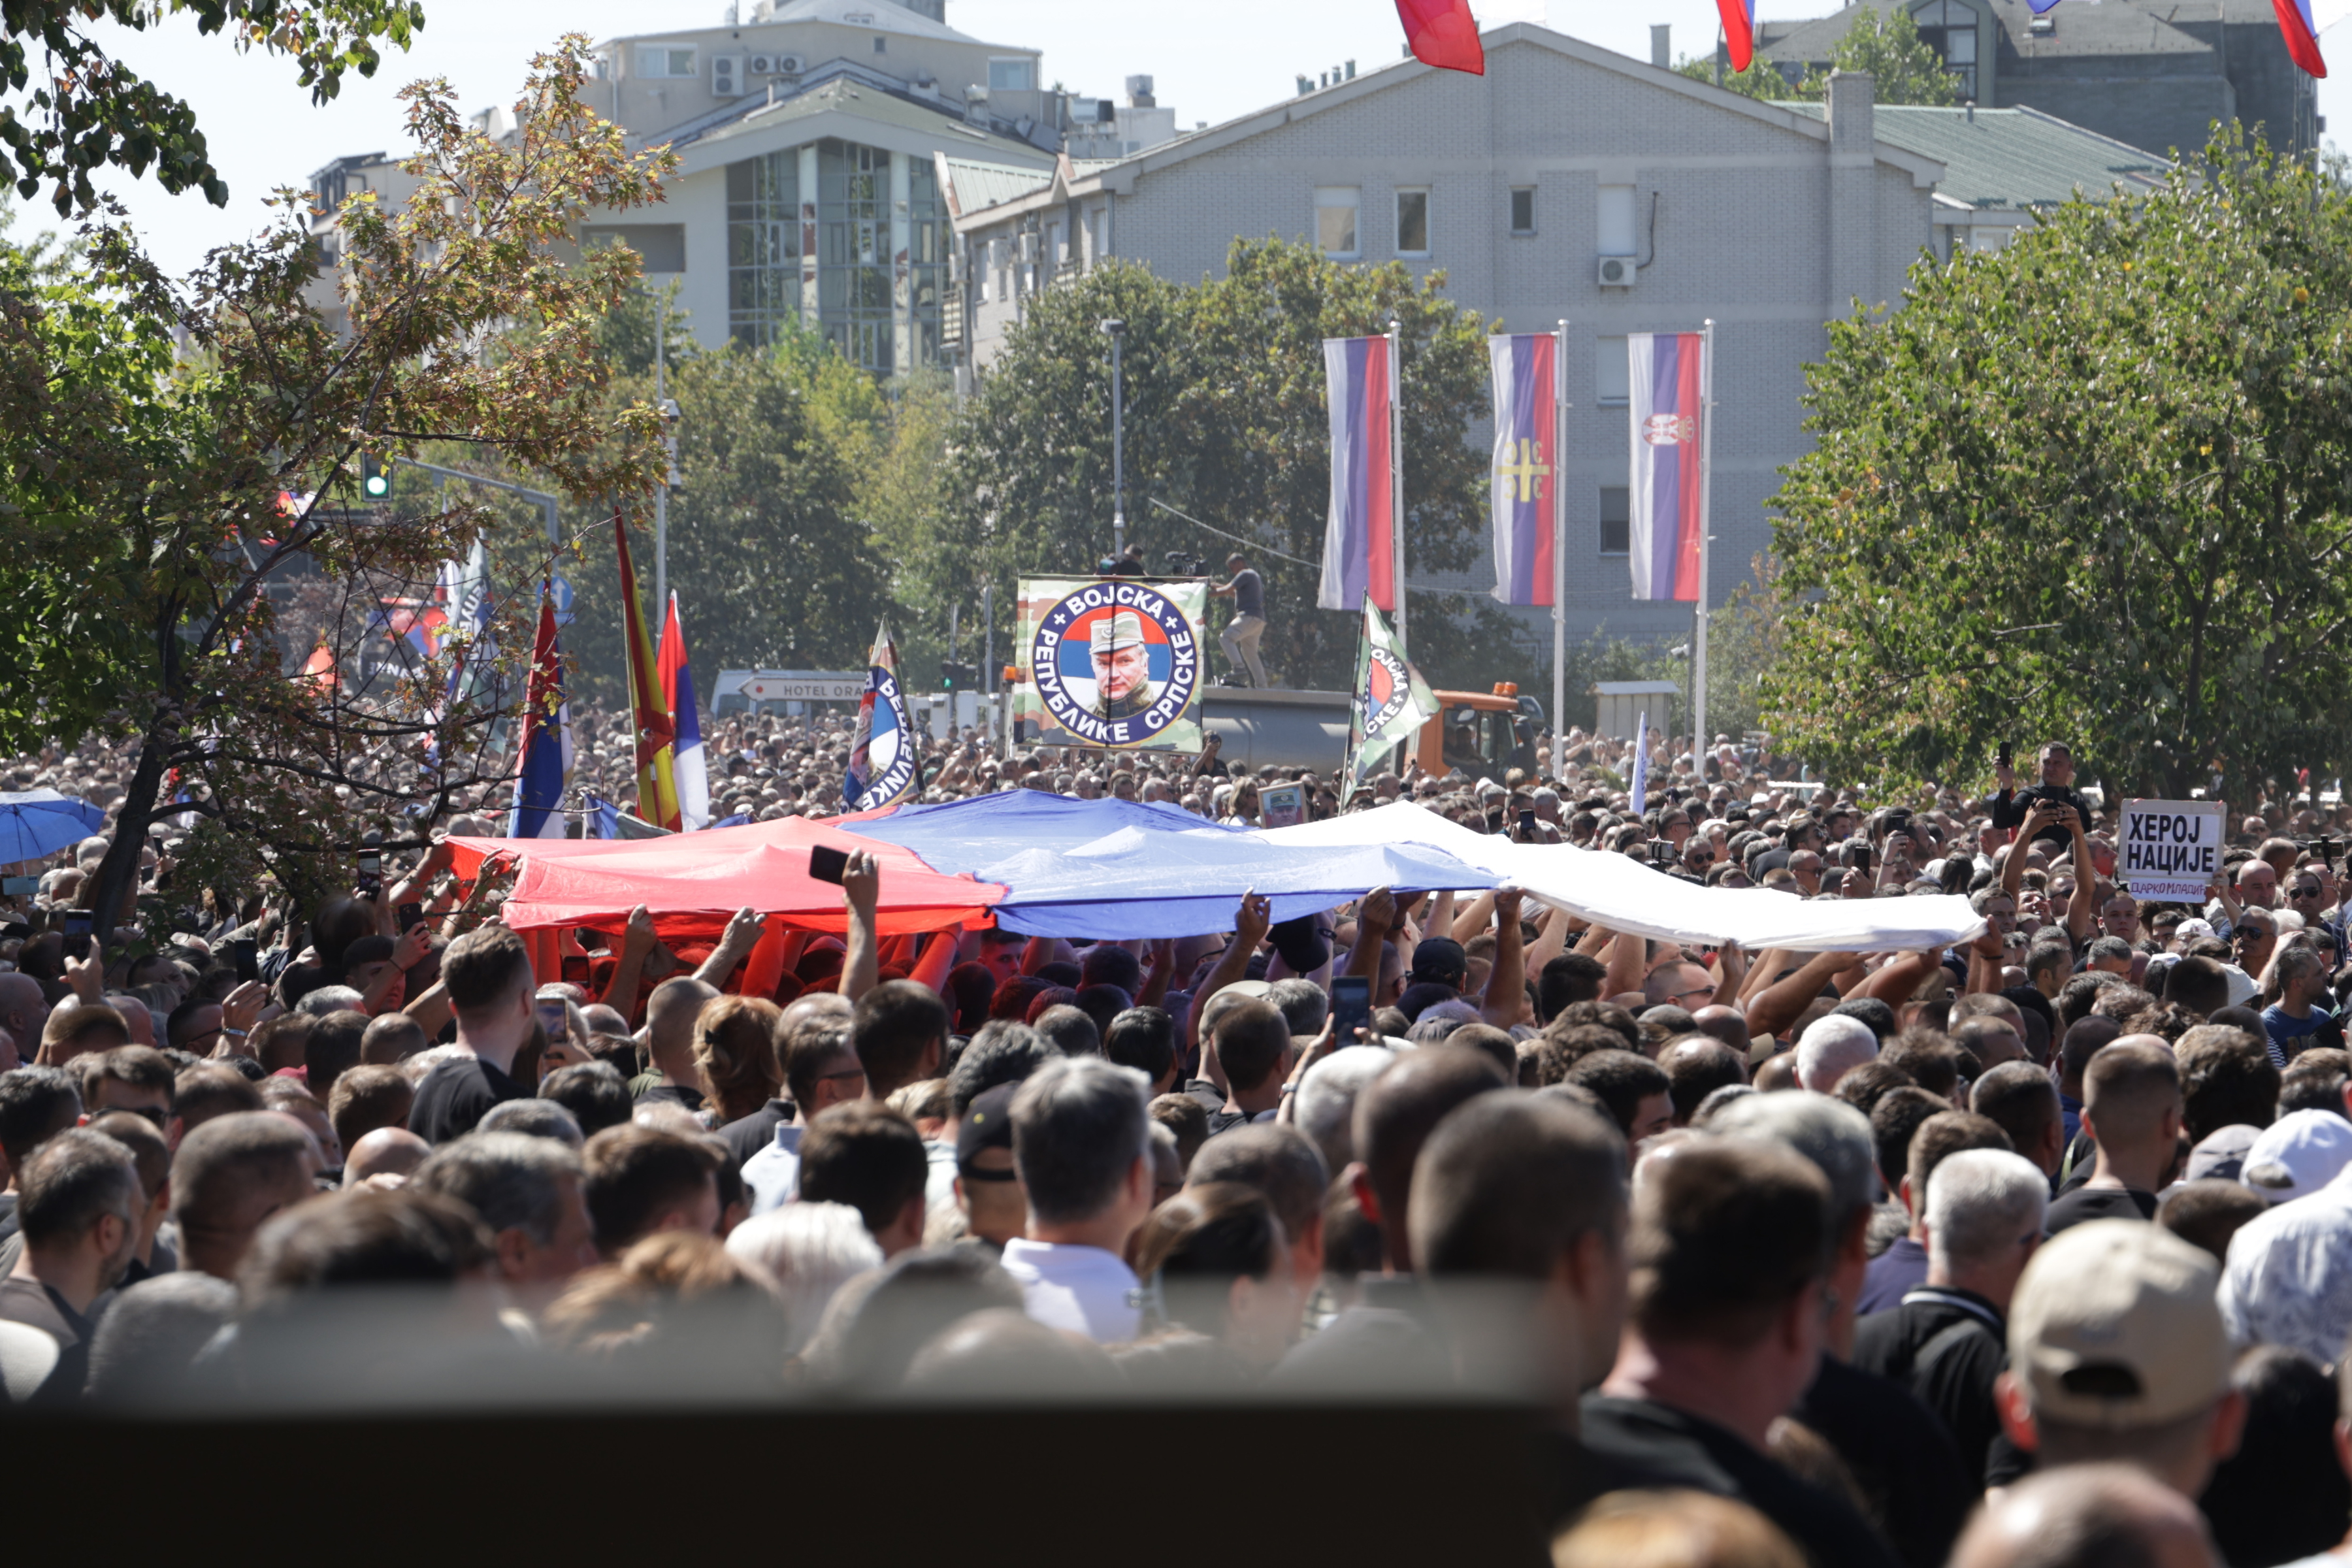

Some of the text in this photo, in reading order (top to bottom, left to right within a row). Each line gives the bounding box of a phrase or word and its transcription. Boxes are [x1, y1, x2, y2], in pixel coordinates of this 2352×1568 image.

[1066, 586, 1165, 619] ВОЈСКА
[1036, 629, 1194, 742] РЕПУБЛИКЕ СРПСКЕ
[1371, 647, 1408, 692] ОЈСКА
[784, 685, 862, 696] HOTEL ORA
[2129, 813, 2200, 843] ХЕРОЈ
[2127, 844, 2213, 875] НАЦИЈЕ
